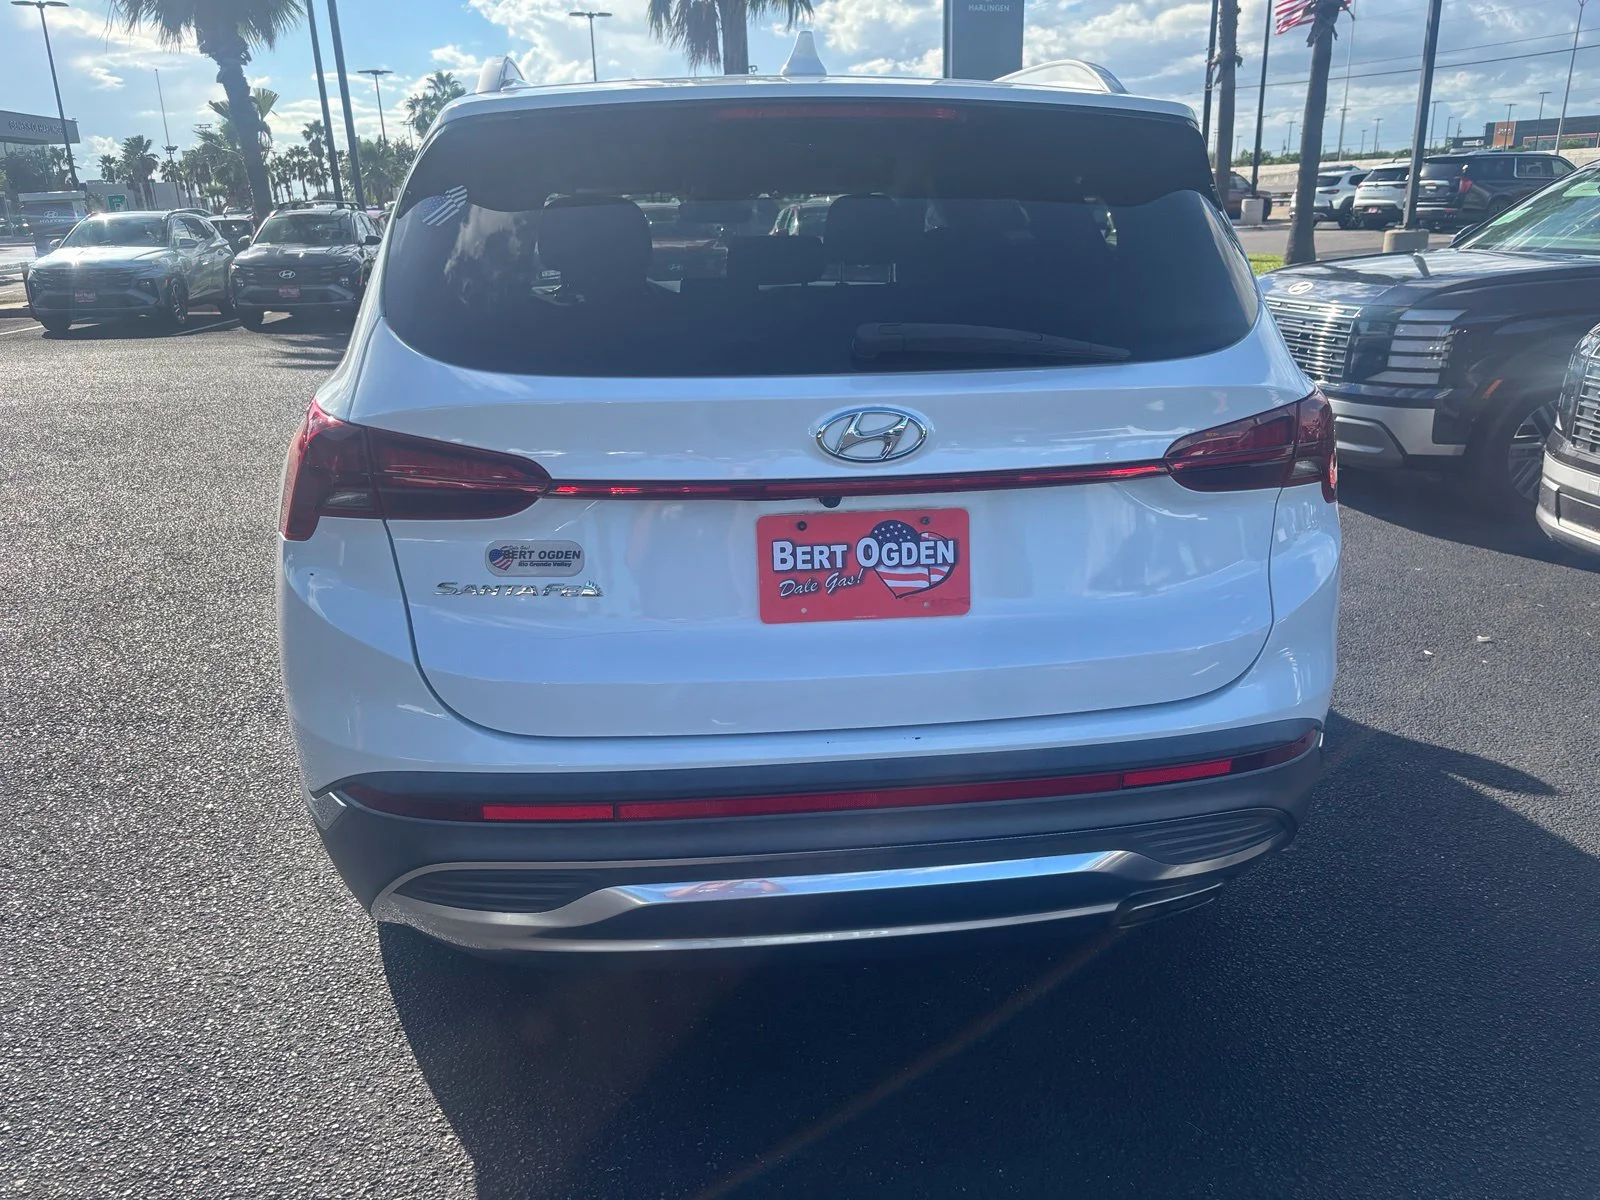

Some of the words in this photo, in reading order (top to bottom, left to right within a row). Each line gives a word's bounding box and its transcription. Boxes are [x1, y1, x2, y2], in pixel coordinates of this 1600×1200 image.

[968, 3, 1010, 12] HARLINGEN
[503, 550, 535, 560] BERT
[538, 550, 581, 560] OGDEN
[772, 540, 848, 571] BERT
[856, 537, 955, 568] OGDEN
[434, 582, 538, 597] SANTA
[779, 578, 818, 597] Dale
[825, 567, 864, 594] Gas!
